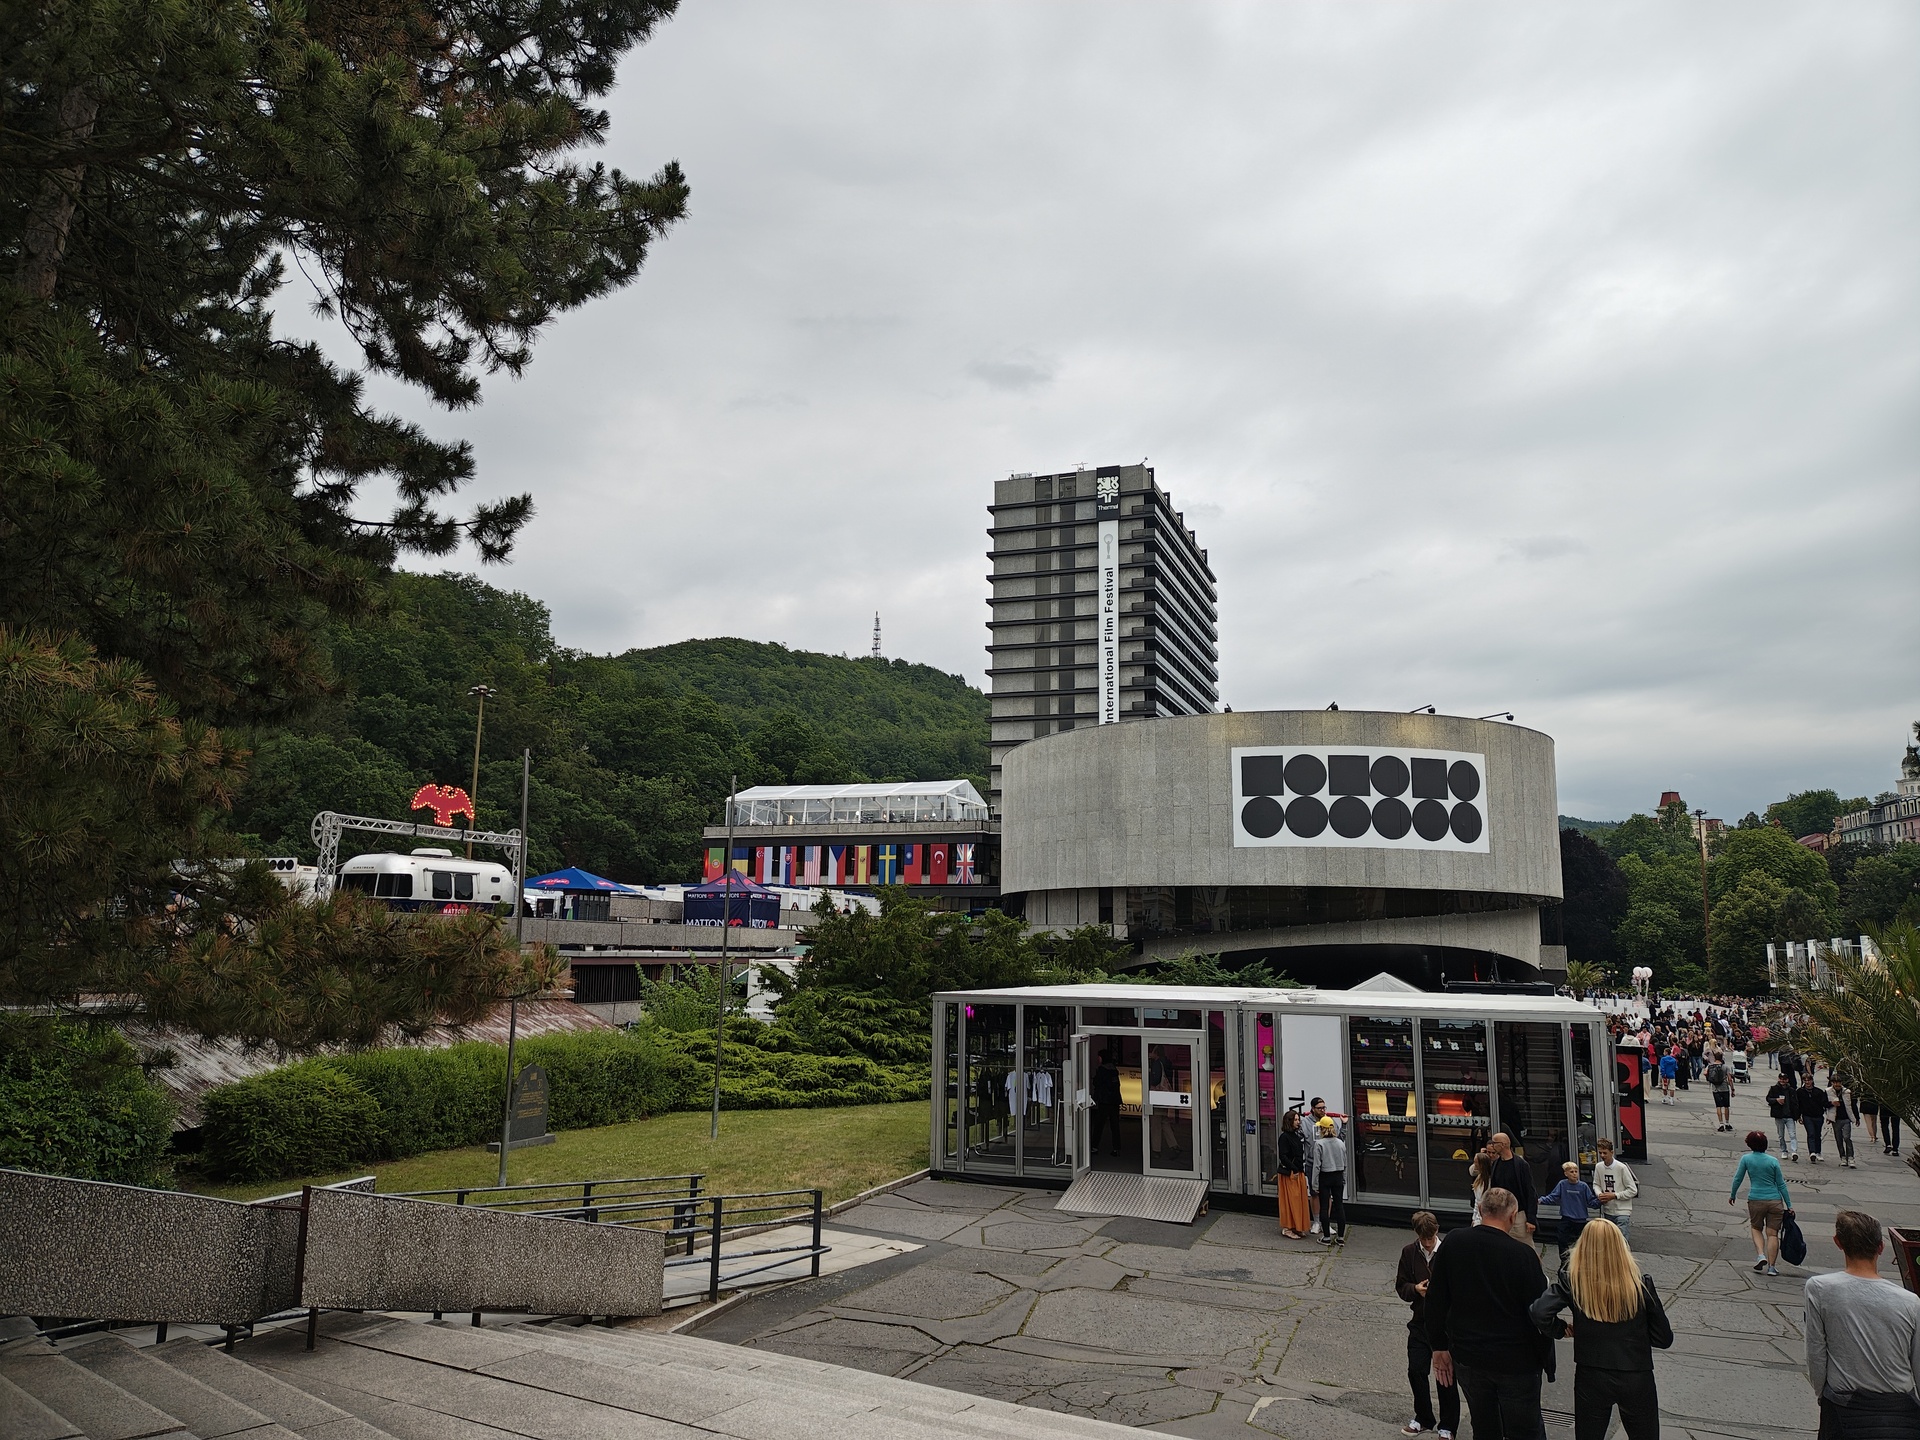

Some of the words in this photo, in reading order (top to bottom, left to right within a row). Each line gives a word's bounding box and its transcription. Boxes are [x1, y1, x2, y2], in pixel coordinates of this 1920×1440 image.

[1104, 567, 1114, 613] Festival
[1104, 617, 1114, 643] Film
[1104, 646, 1114, 724] International
[685, 919, 726, 927] MATTON
